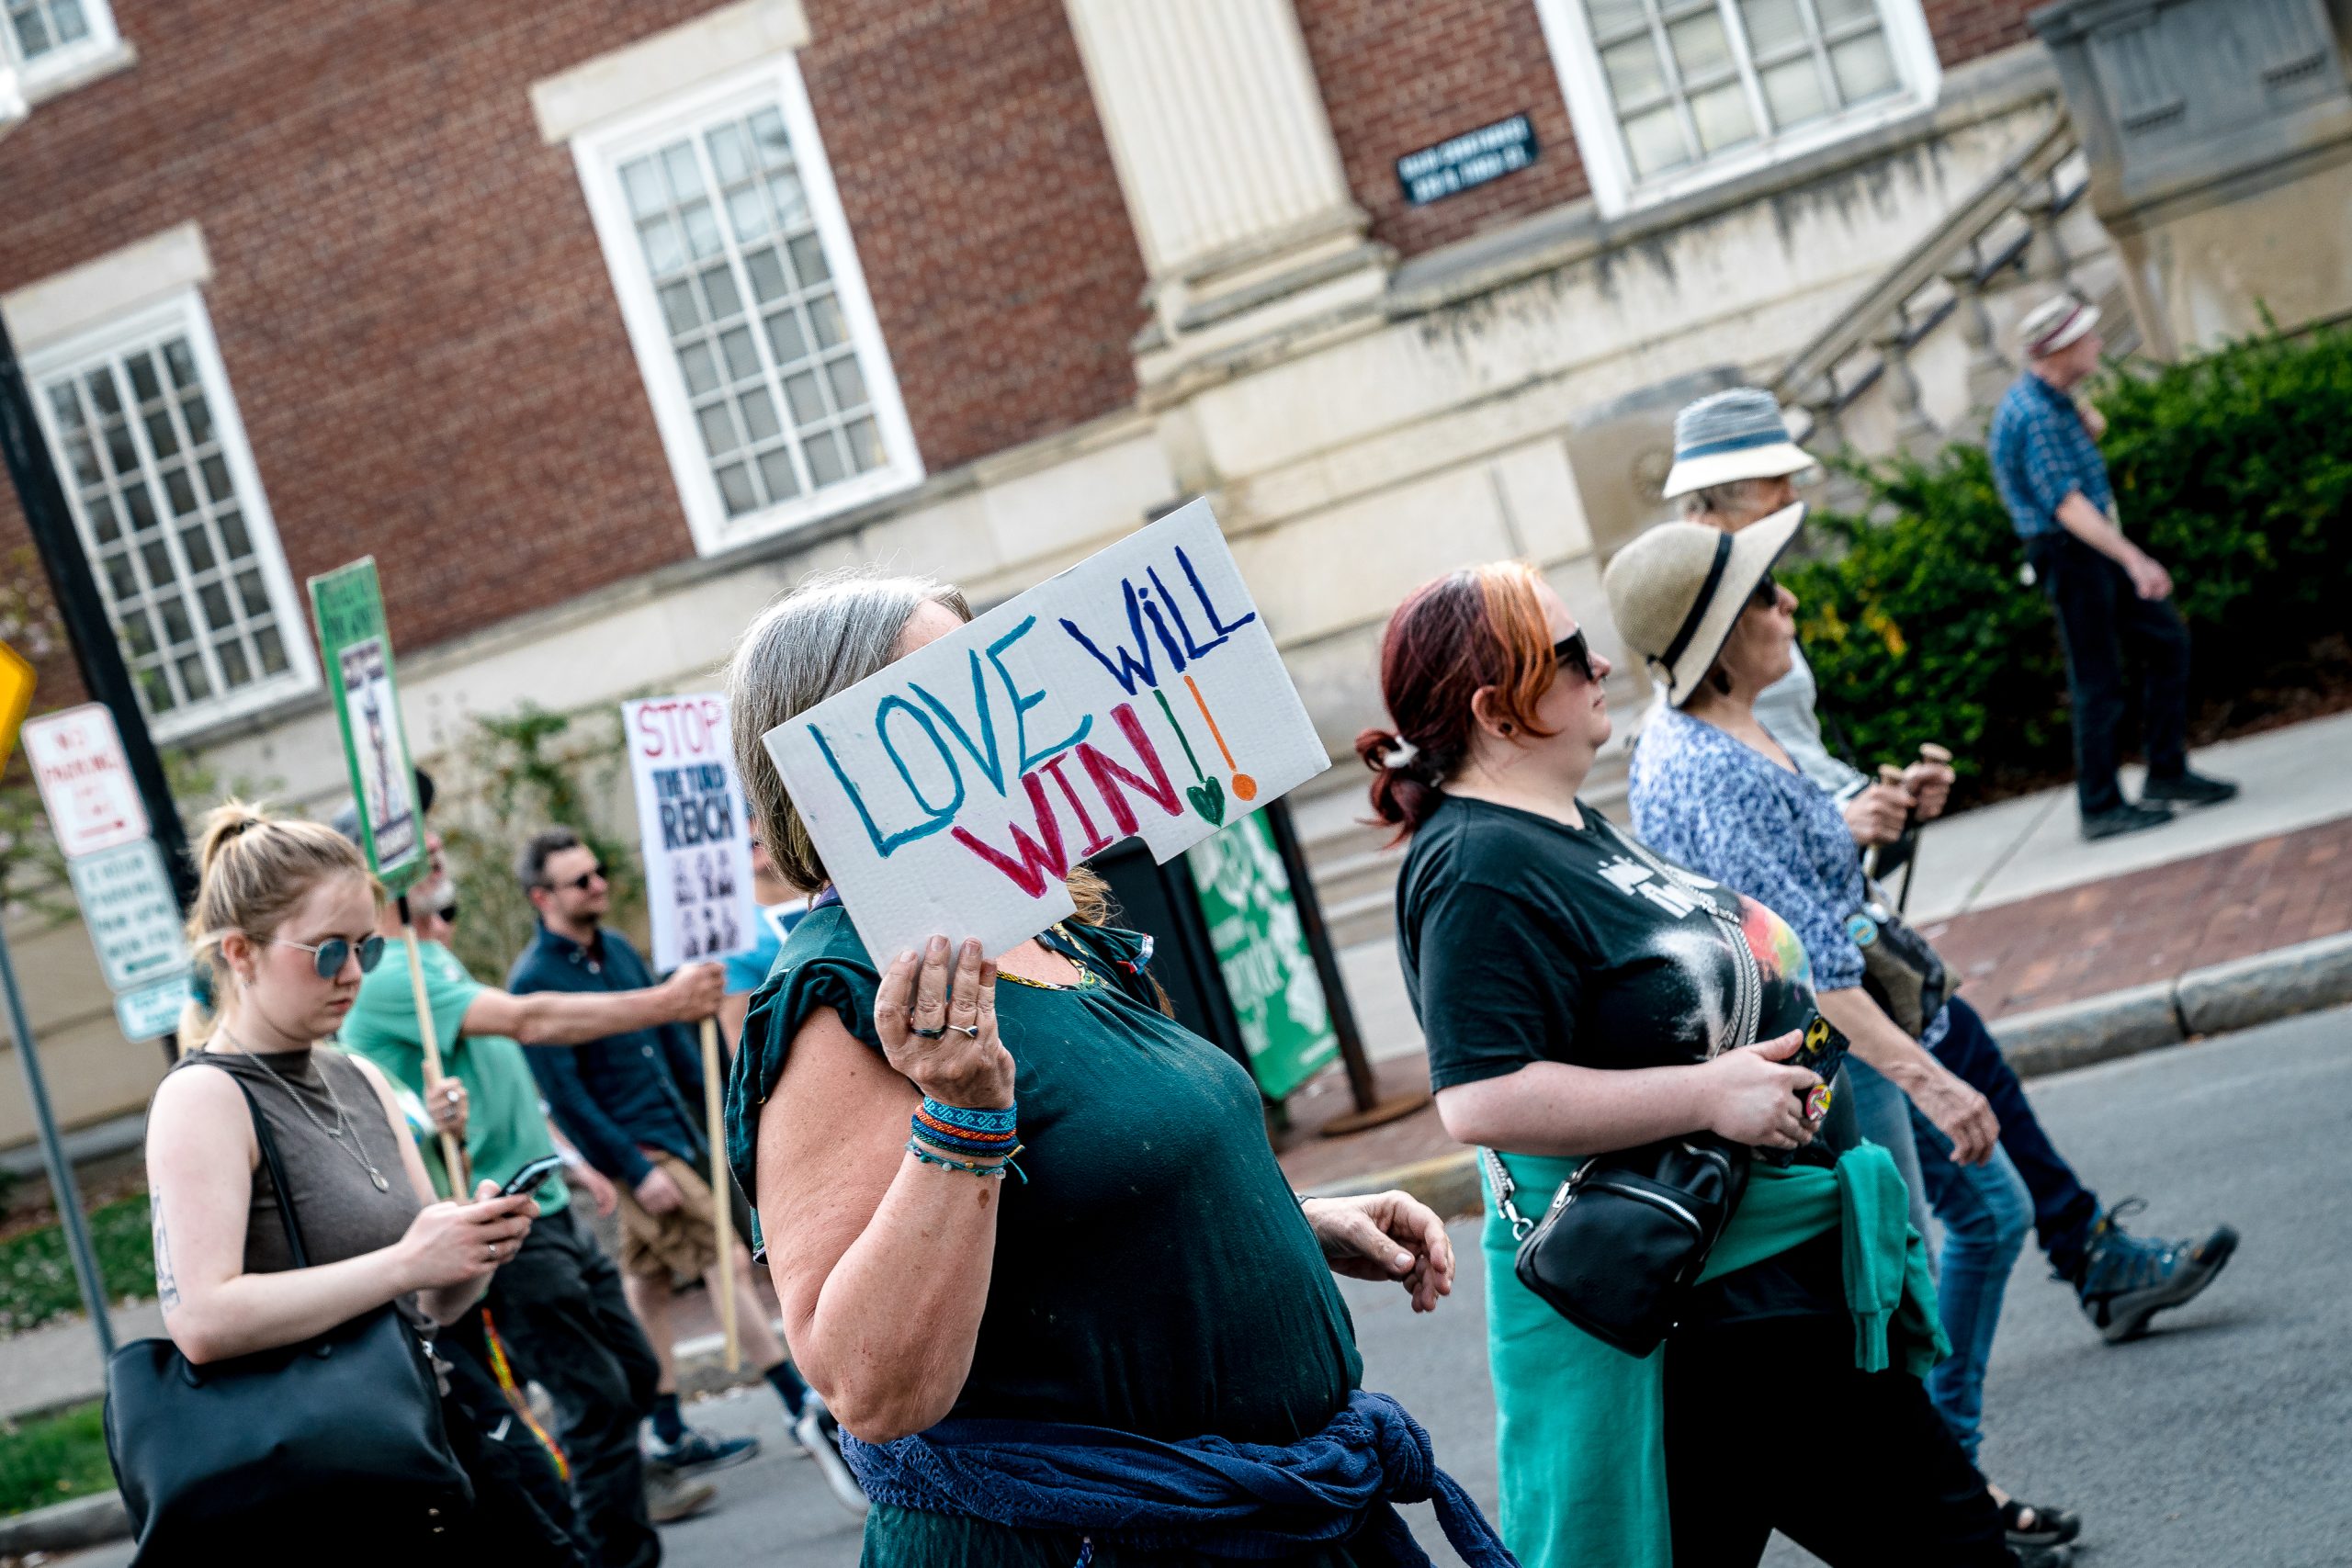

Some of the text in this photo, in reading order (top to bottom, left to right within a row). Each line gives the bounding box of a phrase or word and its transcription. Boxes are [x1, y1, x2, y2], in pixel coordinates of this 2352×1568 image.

[639, 700, 721, 757] STOP
[807, 615, 1093, 858] LOVE
[660, 793, 734, 849] REICH
